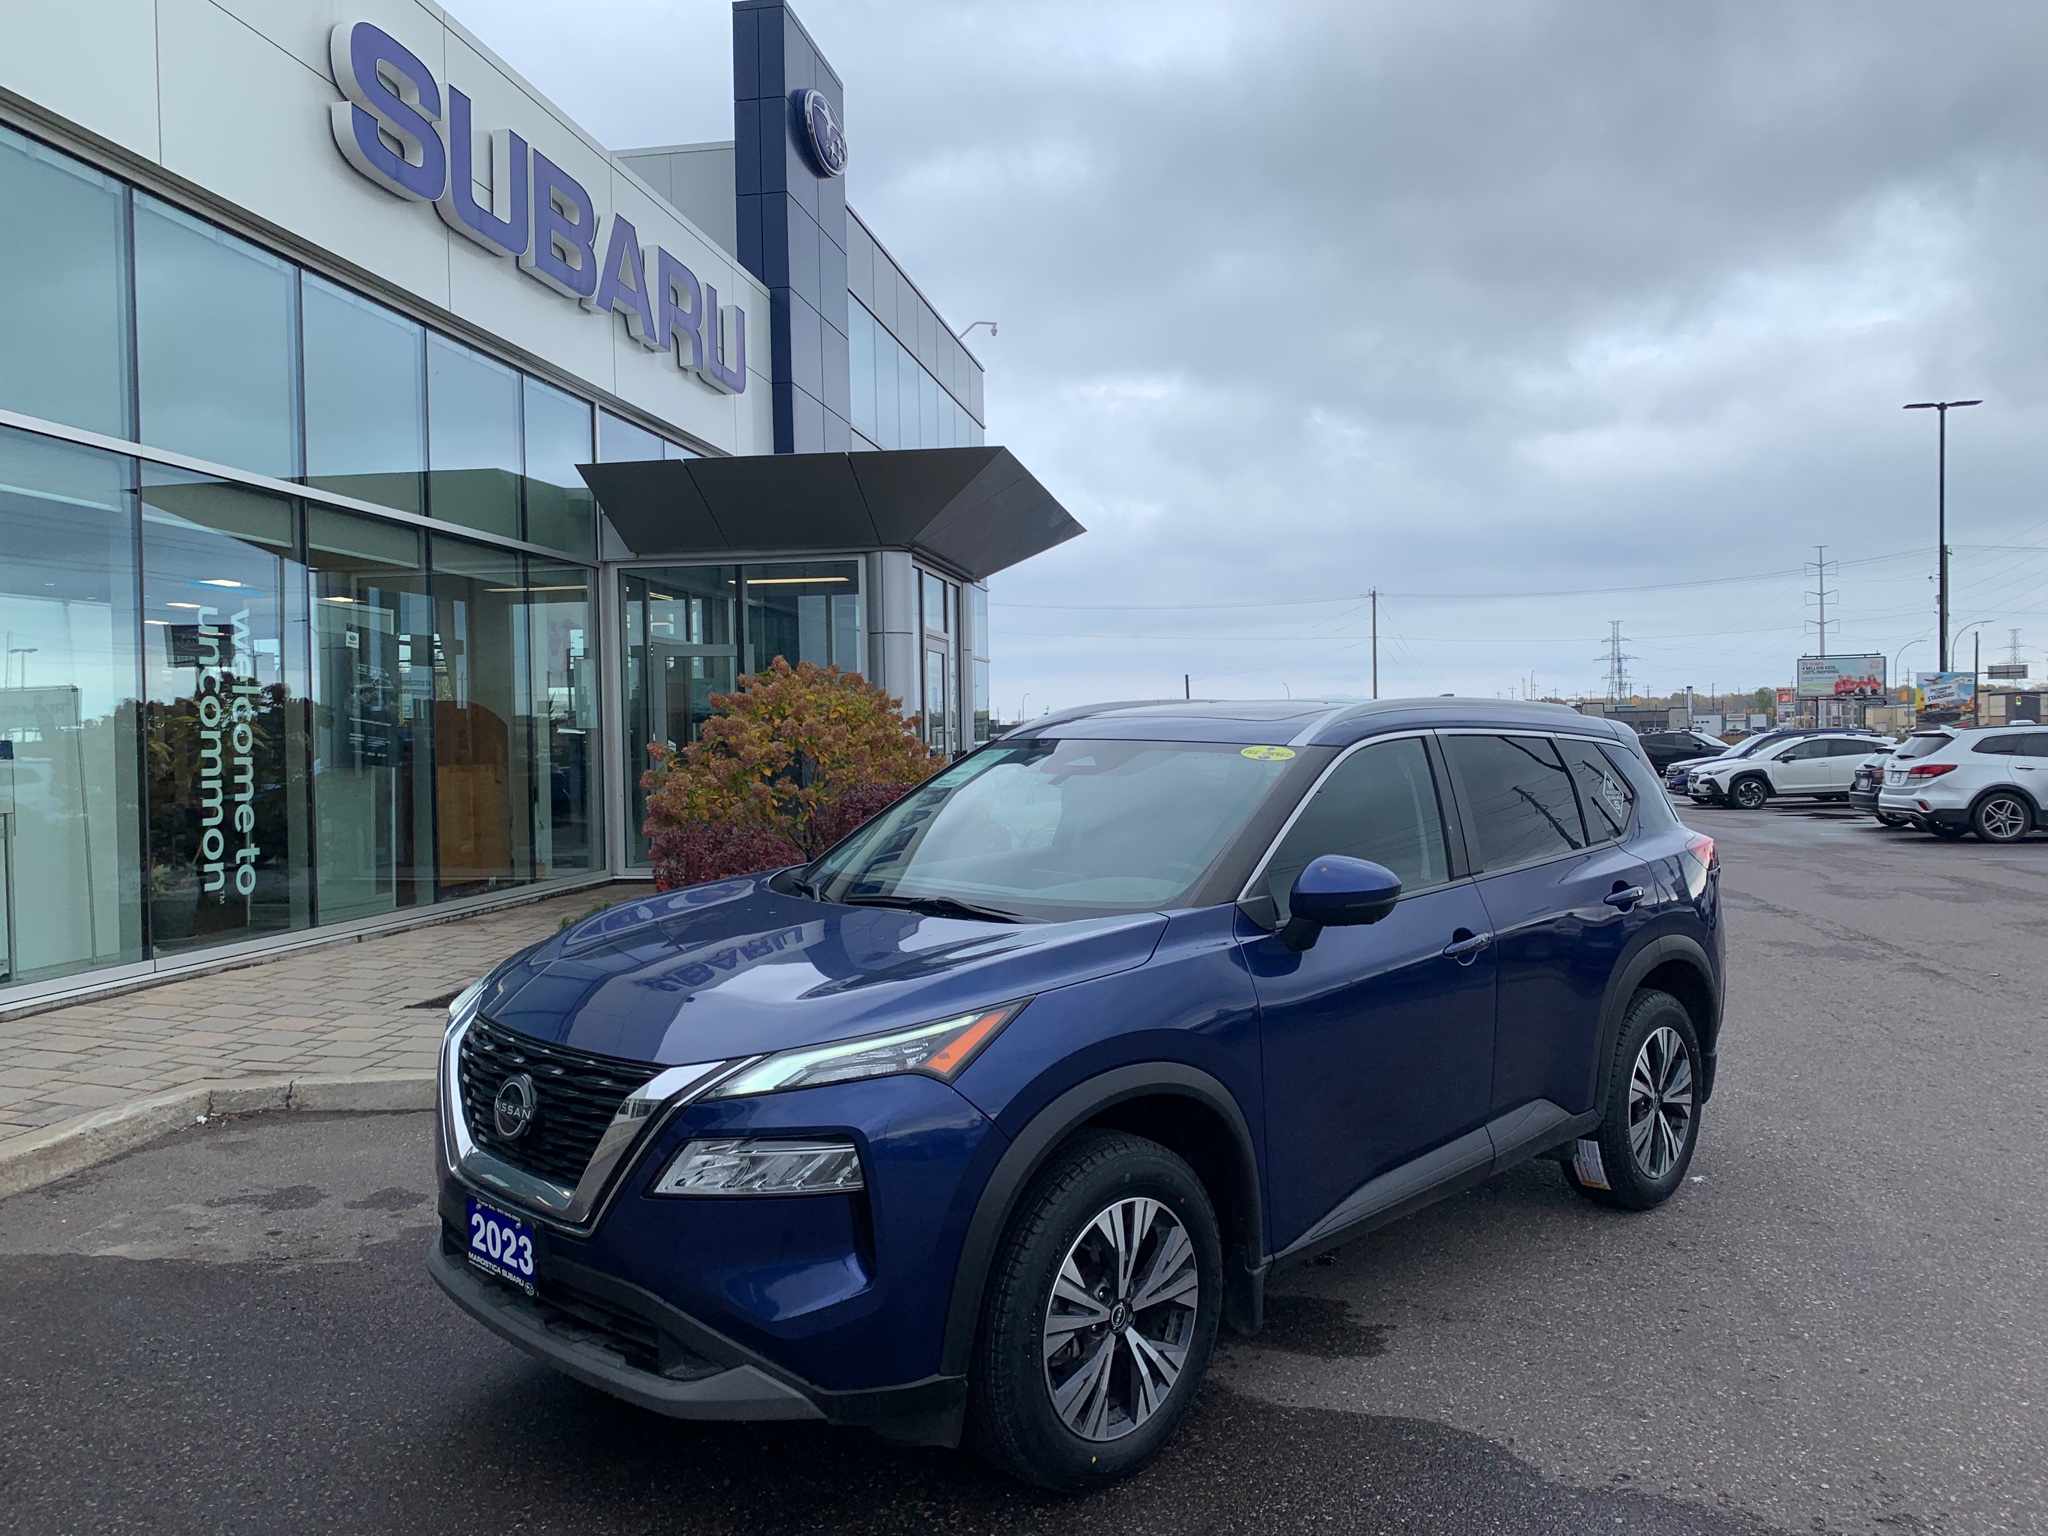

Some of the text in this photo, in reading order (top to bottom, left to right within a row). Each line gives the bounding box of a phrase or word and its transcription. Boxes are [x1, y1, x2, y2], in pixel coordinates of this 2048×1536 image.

[333, 21, 746, 395] SUBARU
[197, 605, 226, 892] uncommon
[231, 608, 261, 896] welcome to
[1927, 691, 1955, 702] STANDARD
[468, 1251, 525, 1287] MAROSTICA SUBARU
[471, 1212, 534, 1276] 2023
